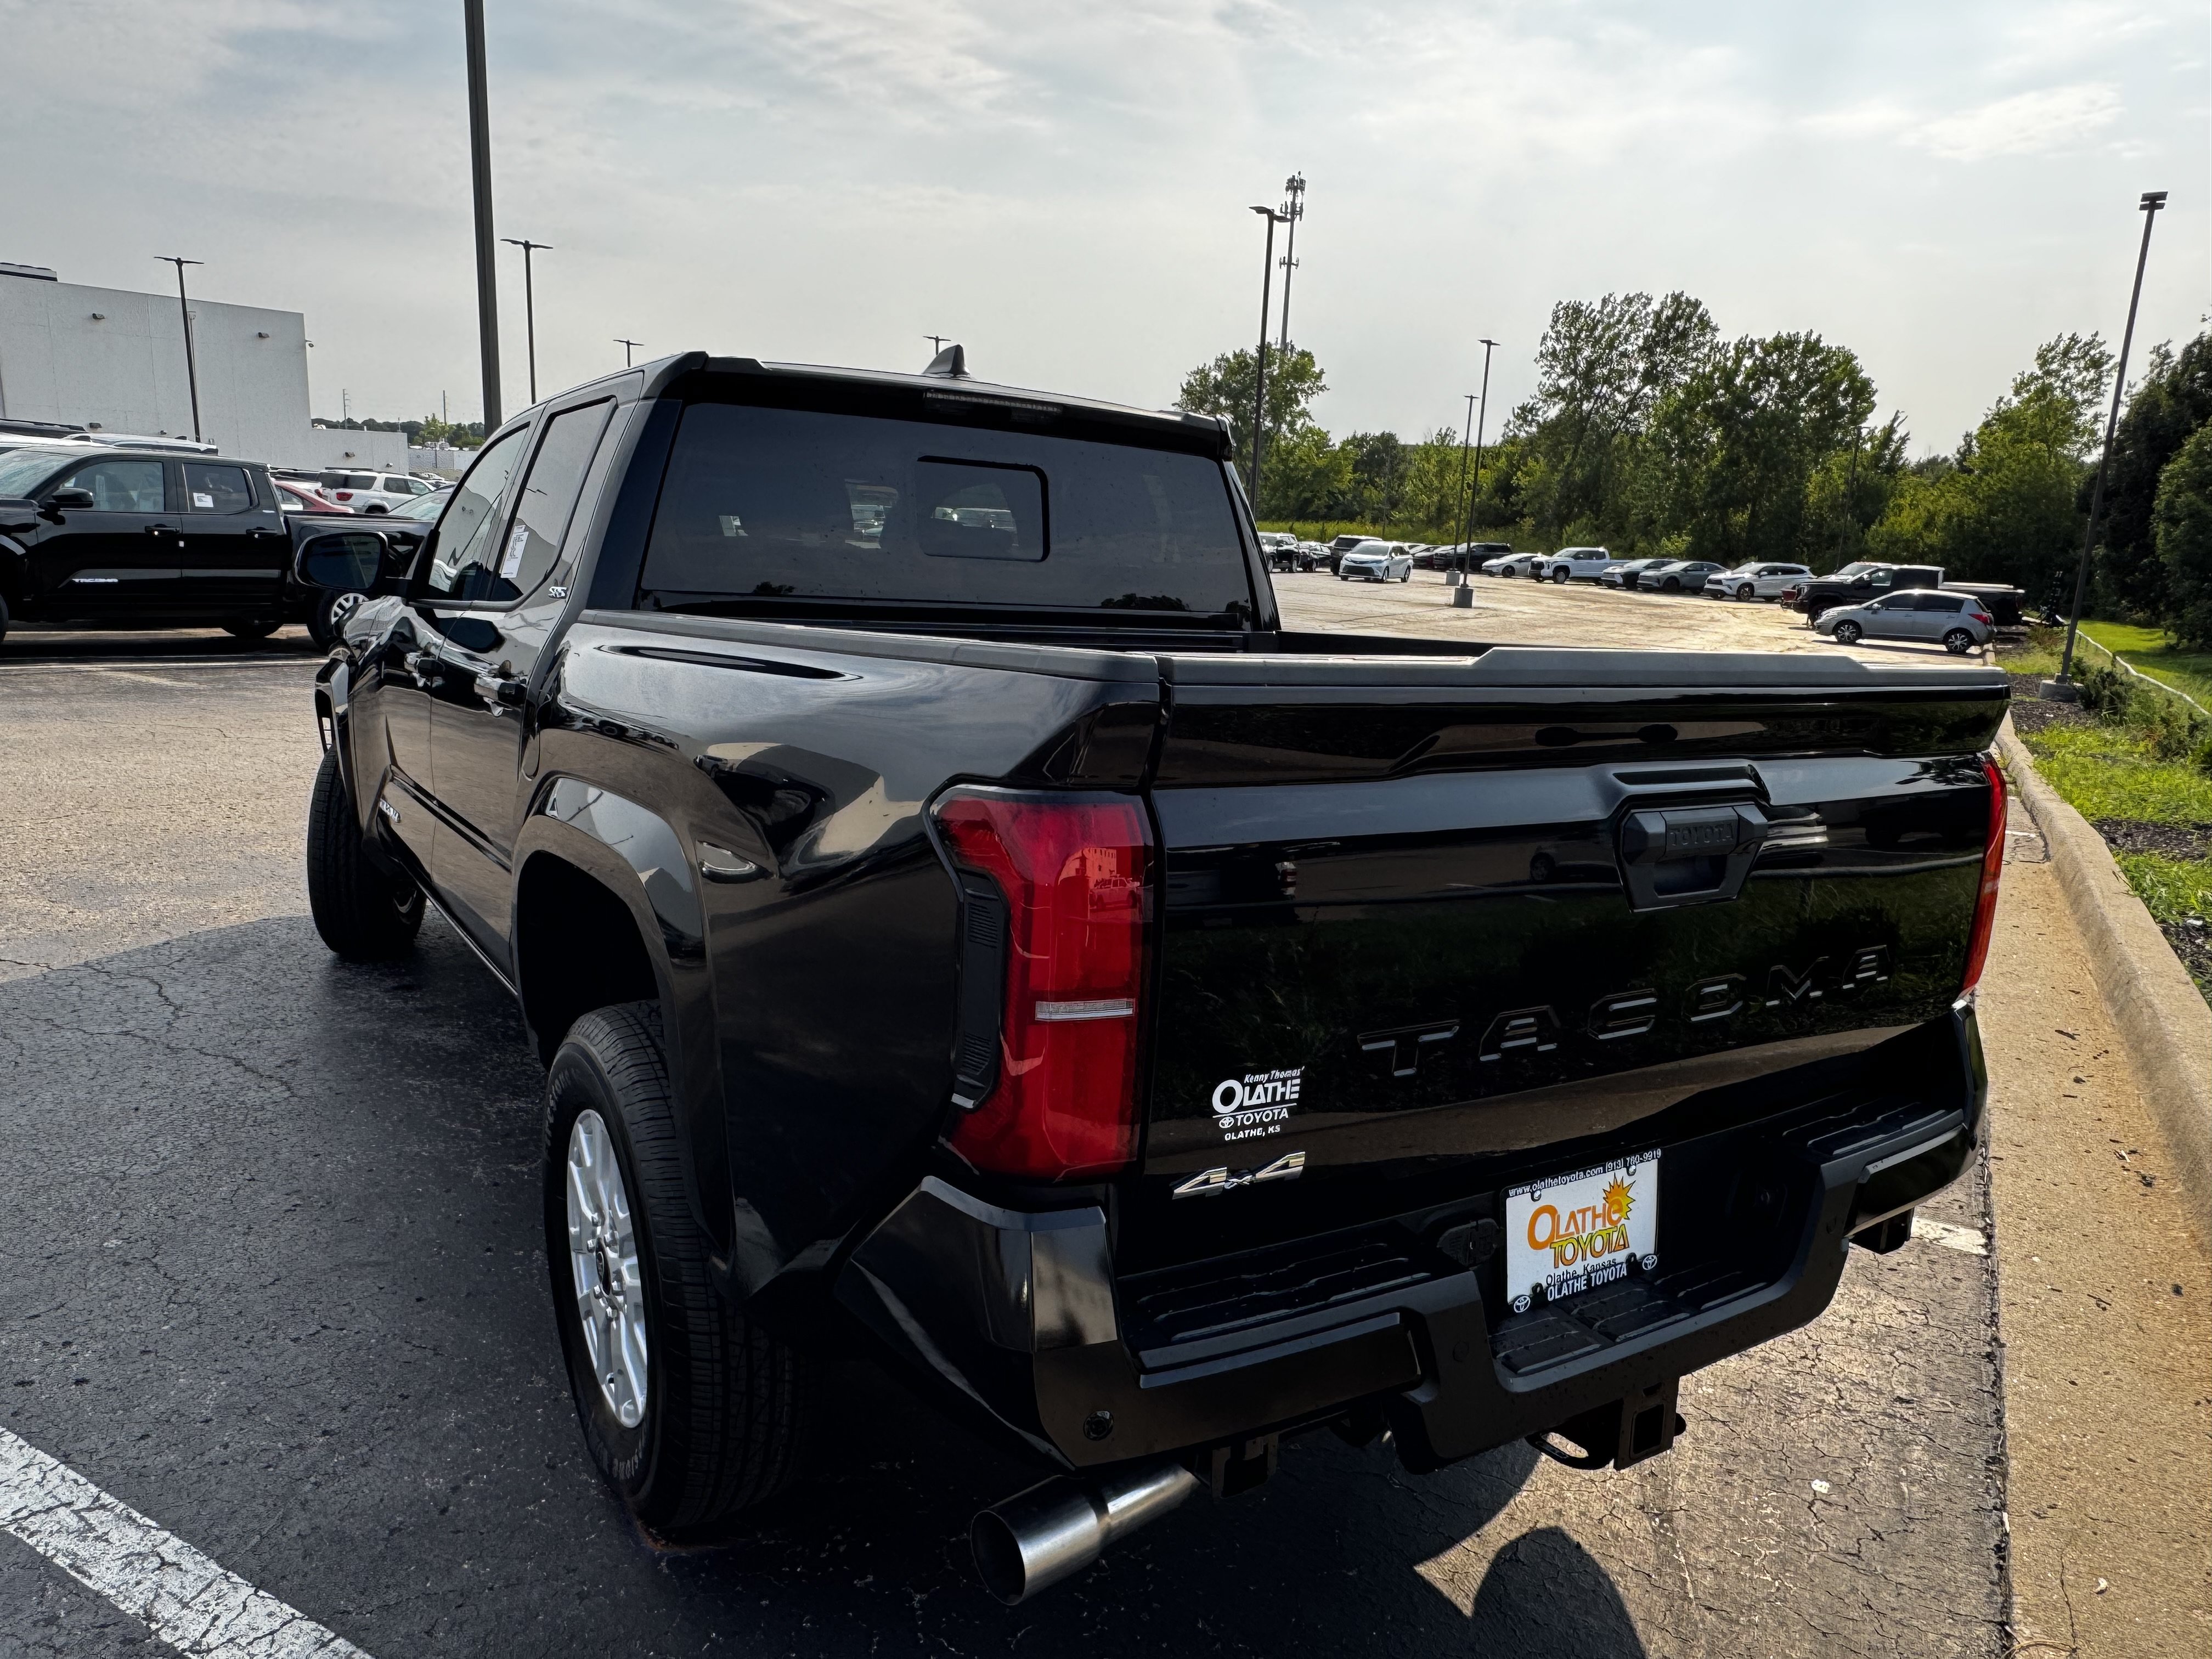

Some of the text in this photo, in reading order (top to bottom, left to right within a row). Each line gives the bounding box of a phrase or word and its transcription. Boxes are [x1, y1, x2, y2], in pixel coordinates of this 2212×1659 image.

[1668, 823, 1734, 847] TOYOTA
[1357, 944, 1891, 1078] TACOMA
[1244, 1073, 1269, 1084] Kenny
[1212, 1079, 1301, 1114] OLATHE
[1236, 1108, 1289, 1126] TOYOTA
[1224, 1124, 1280, 1141] OLATHE, KS
[1508, 1166, 1604, 1197] www.olathetoyota.com
[1606, 1158, 1623, 1174] (913)
[1549, 1223, 1630, 1269] TOYOTA
[1583, 1259, 1617, 1274] Kansas
[1547, 1264, 1627, 1301] OLATHE TOYOTA
